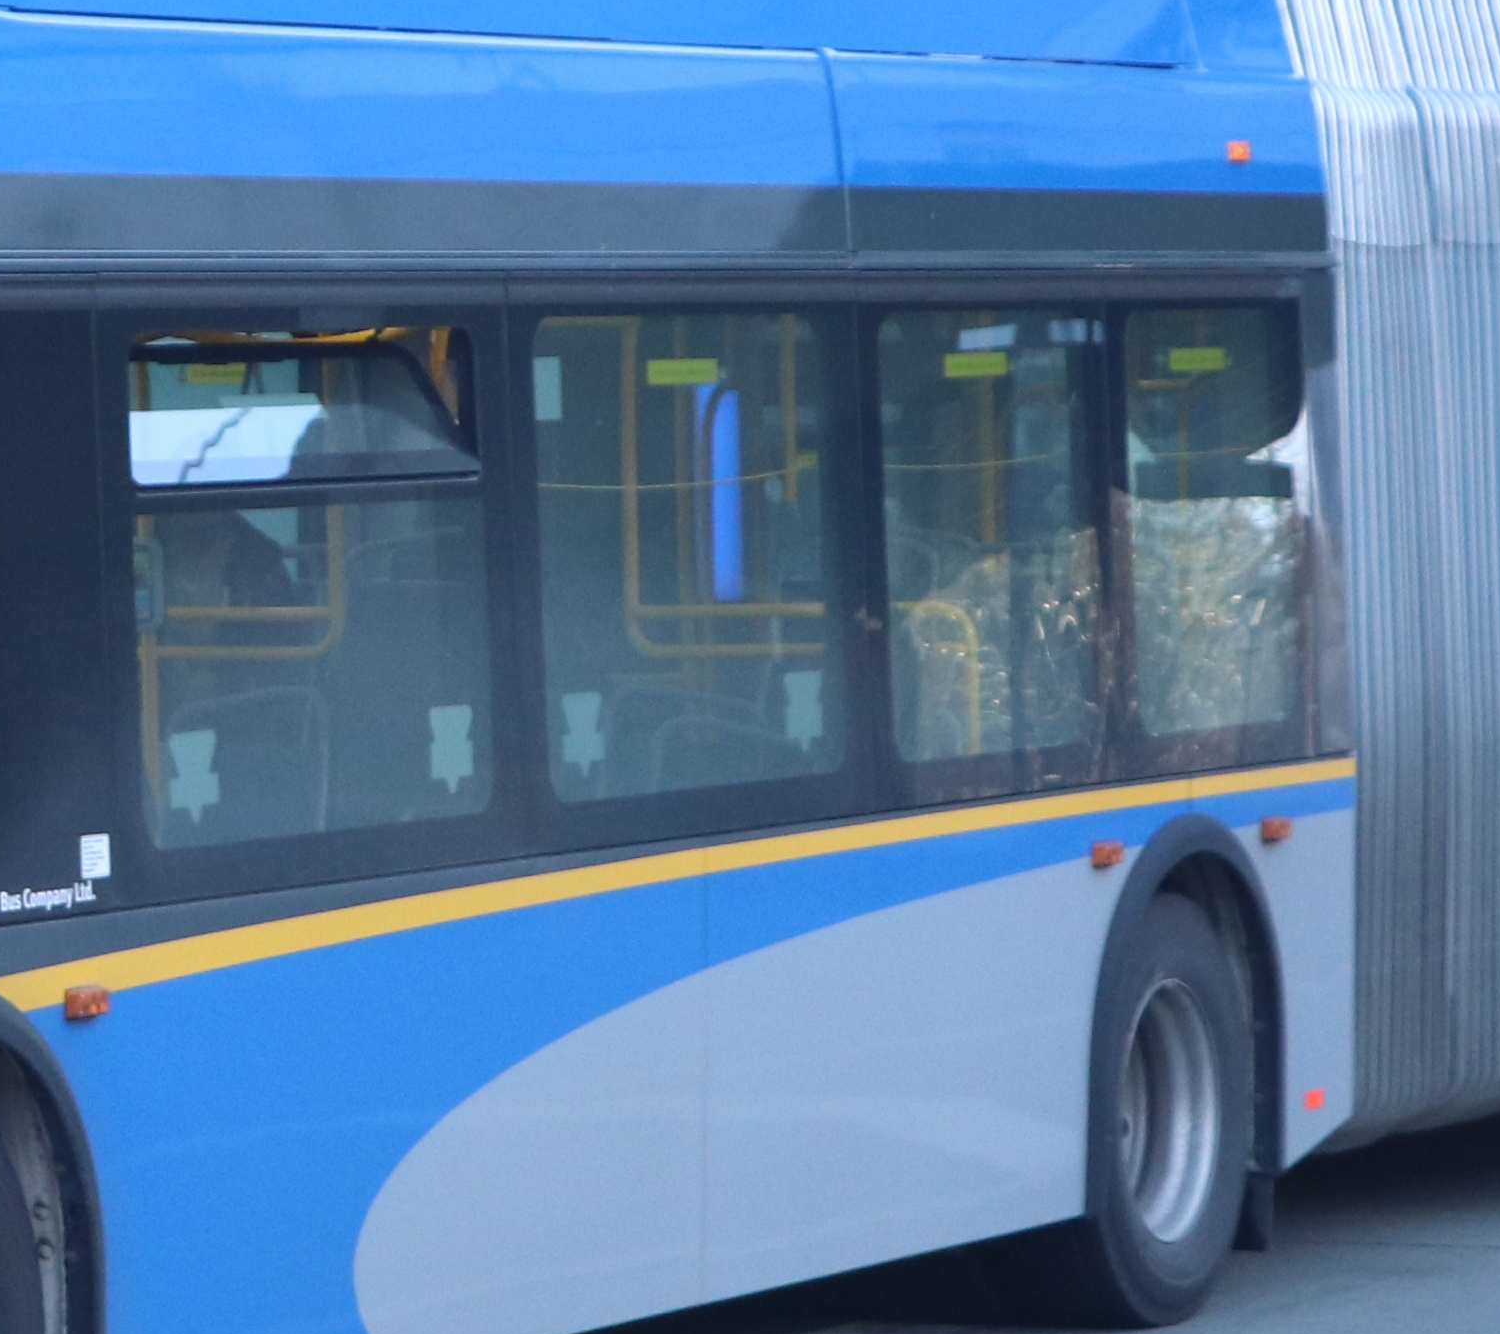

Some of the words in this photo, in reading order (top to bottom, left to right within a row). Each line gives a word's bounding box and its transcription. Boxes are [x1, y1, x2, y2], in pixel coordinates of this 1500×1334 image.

[0, 891, 22, 911] Bus
[23, 887, 73, 911] Company
[74, 880, 97, 902] Ltd.
